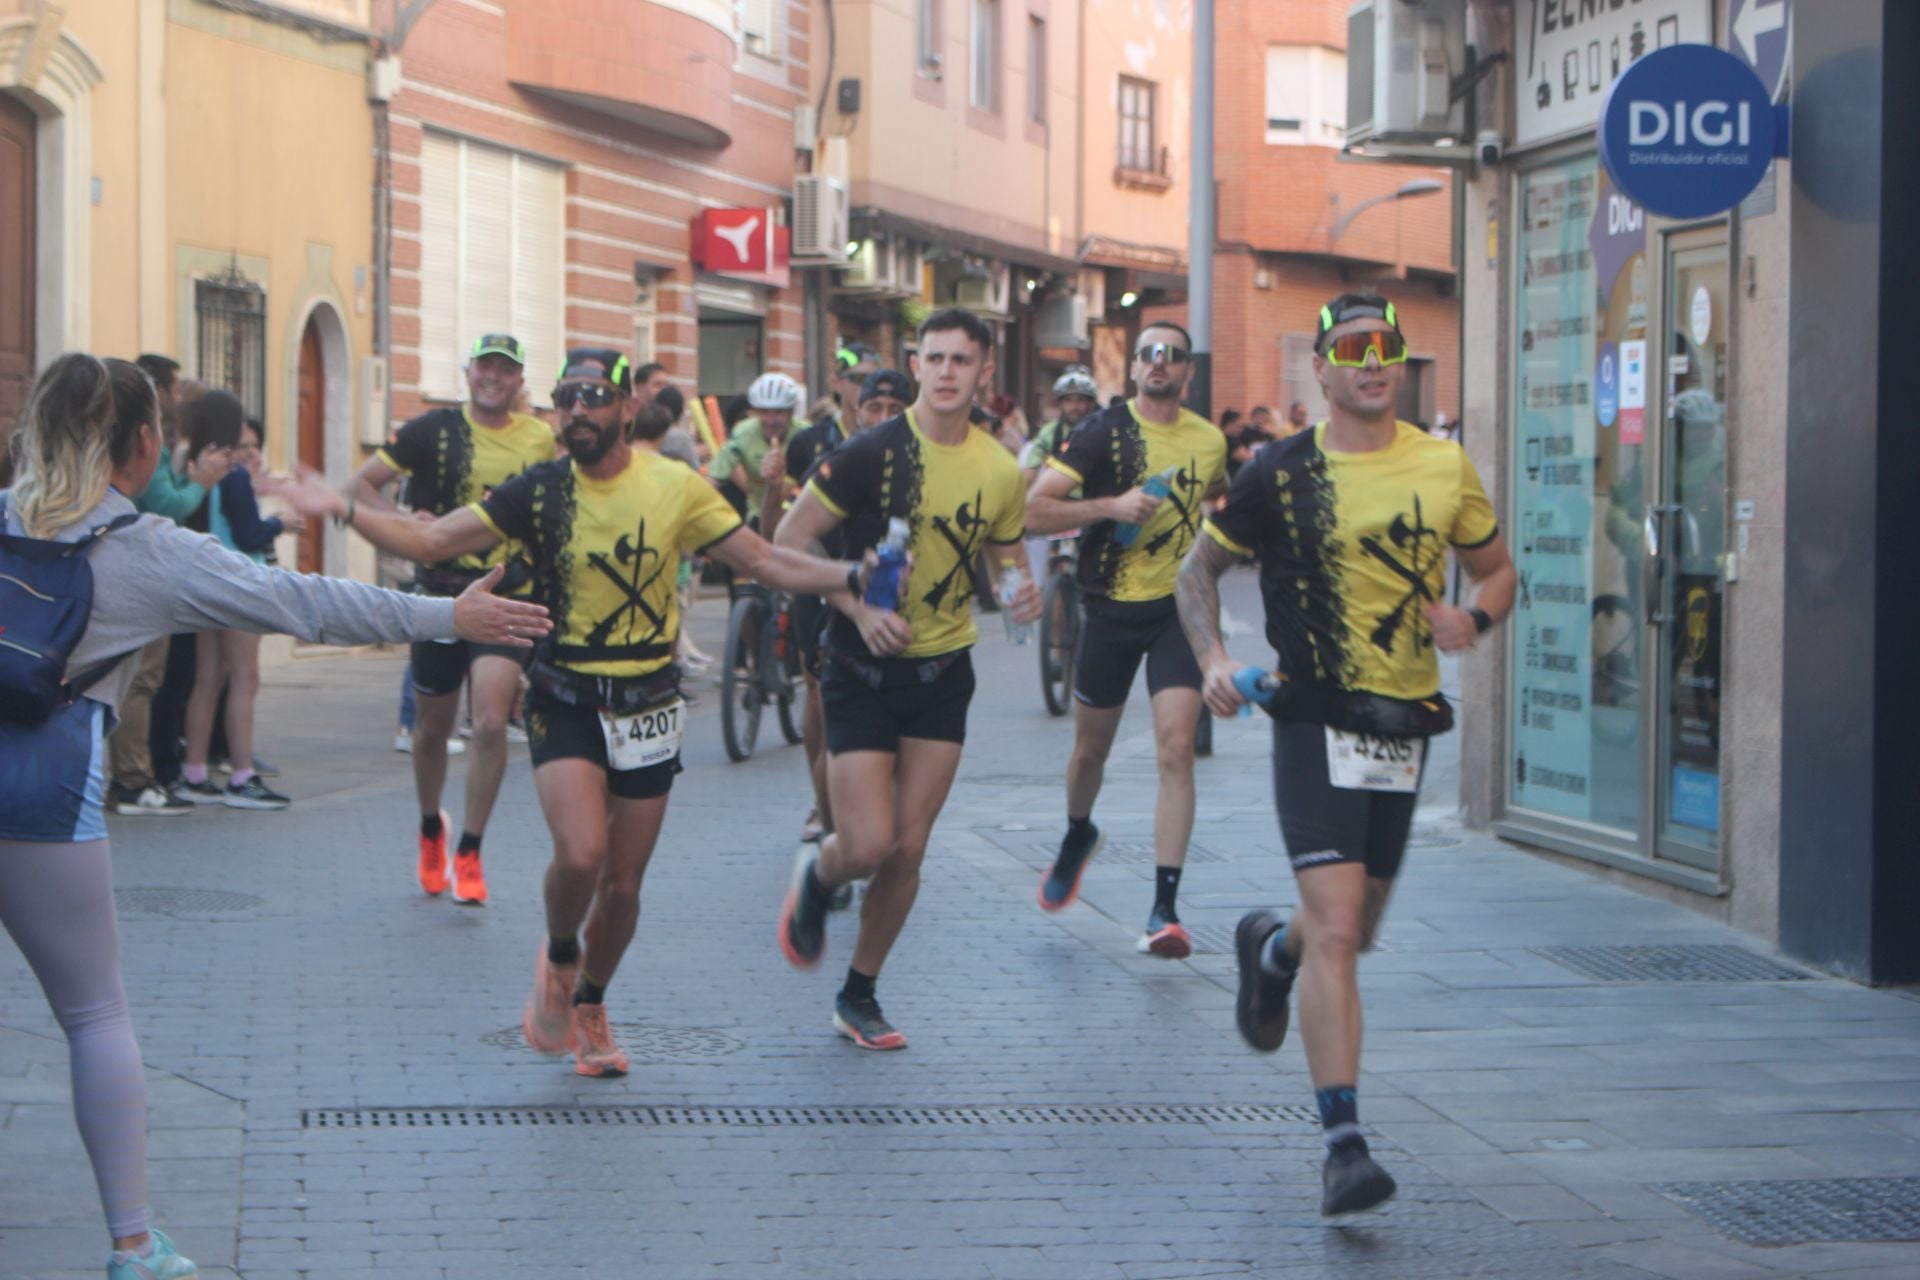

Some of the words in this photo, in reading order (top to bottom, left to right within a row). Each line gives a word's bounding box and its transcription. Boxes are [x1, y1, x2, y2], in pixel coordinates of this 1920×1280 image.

[1629, 100, 1750, 146] DIGI
[1629, 151, 1705, 165] Distribuidor
[1706, 151, 1749, 165] oficial
[629, 707, 678, 742] 4207
